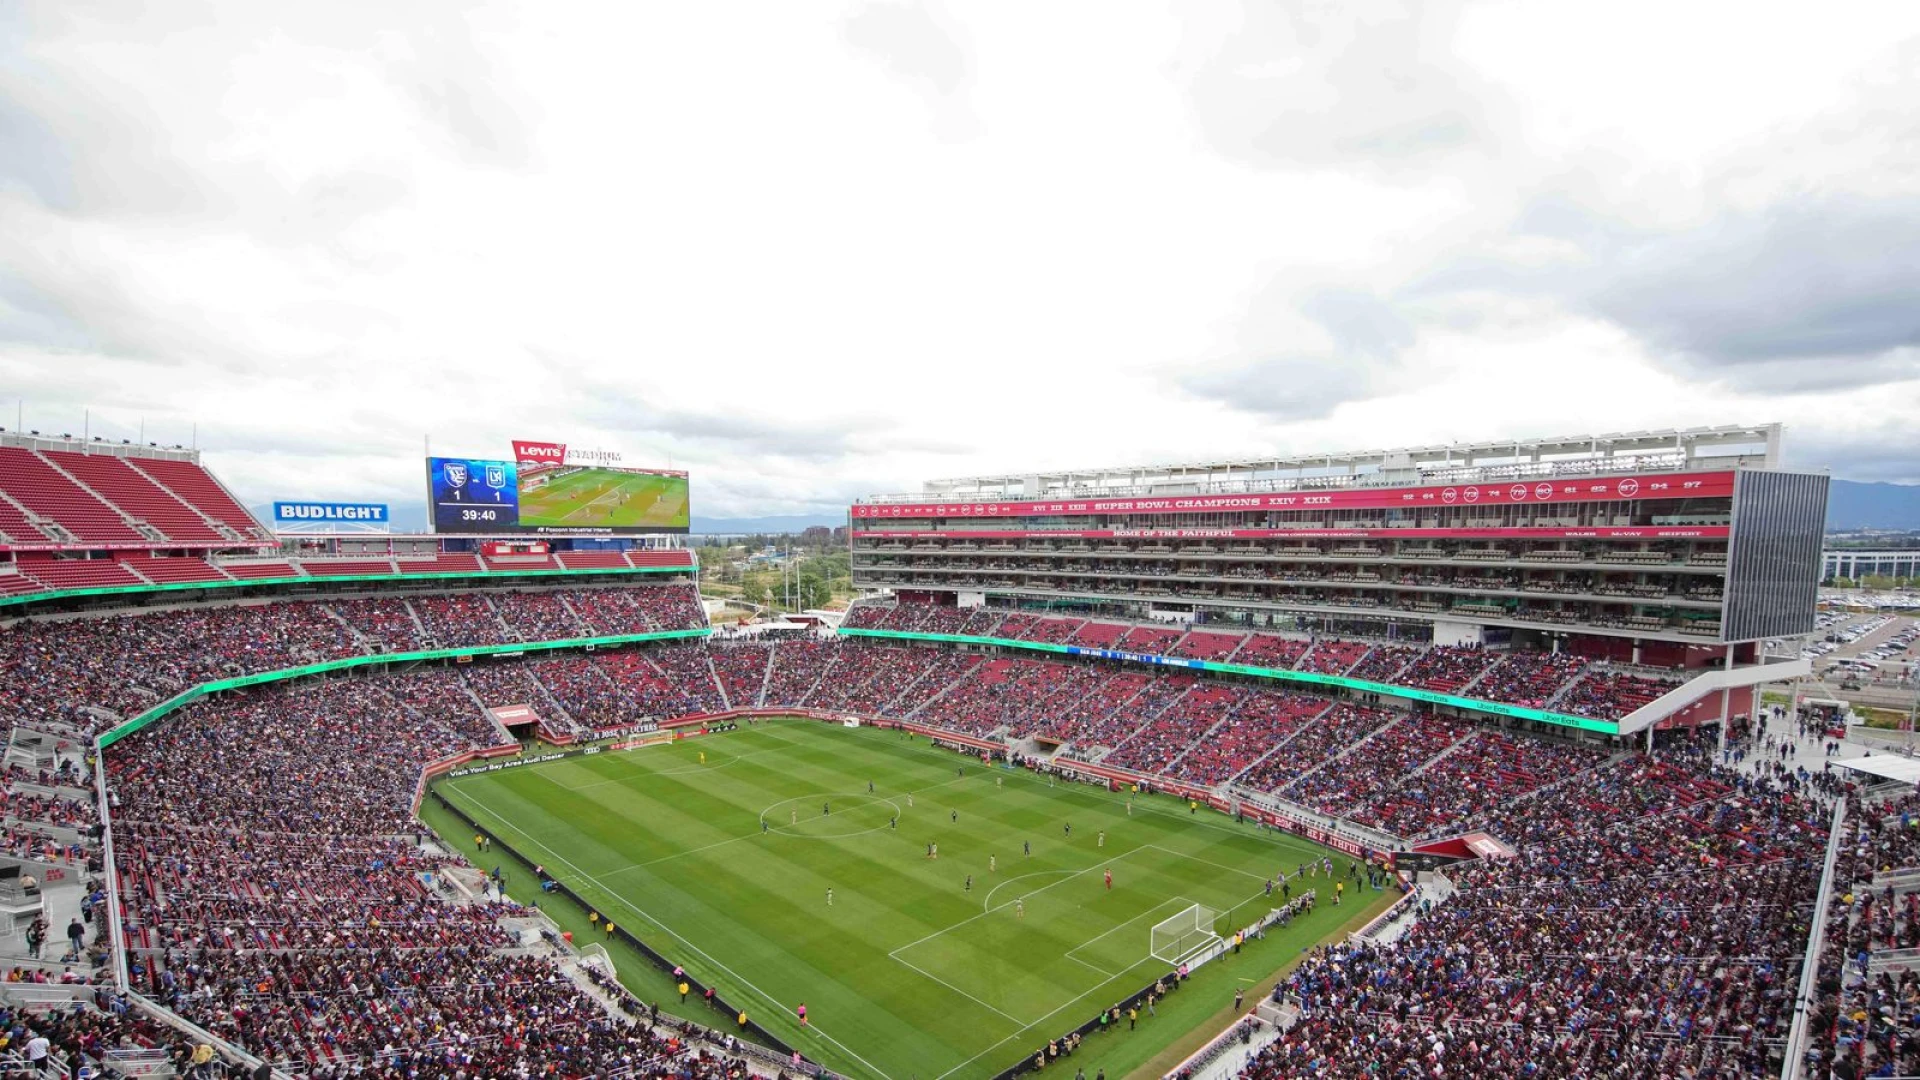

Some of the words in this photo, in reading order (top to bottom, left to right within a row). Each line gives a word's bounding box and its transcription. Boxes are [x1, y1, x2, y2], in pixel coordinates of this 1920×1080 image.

[454, 490, 460, 500] 1
[494, 492, 500, 502] 1
[1175, 498, 1260, 508] CHAMPIONS
[462, 510, 496, 520] 39:40
[1561, 716, 1580, 726] Eats
